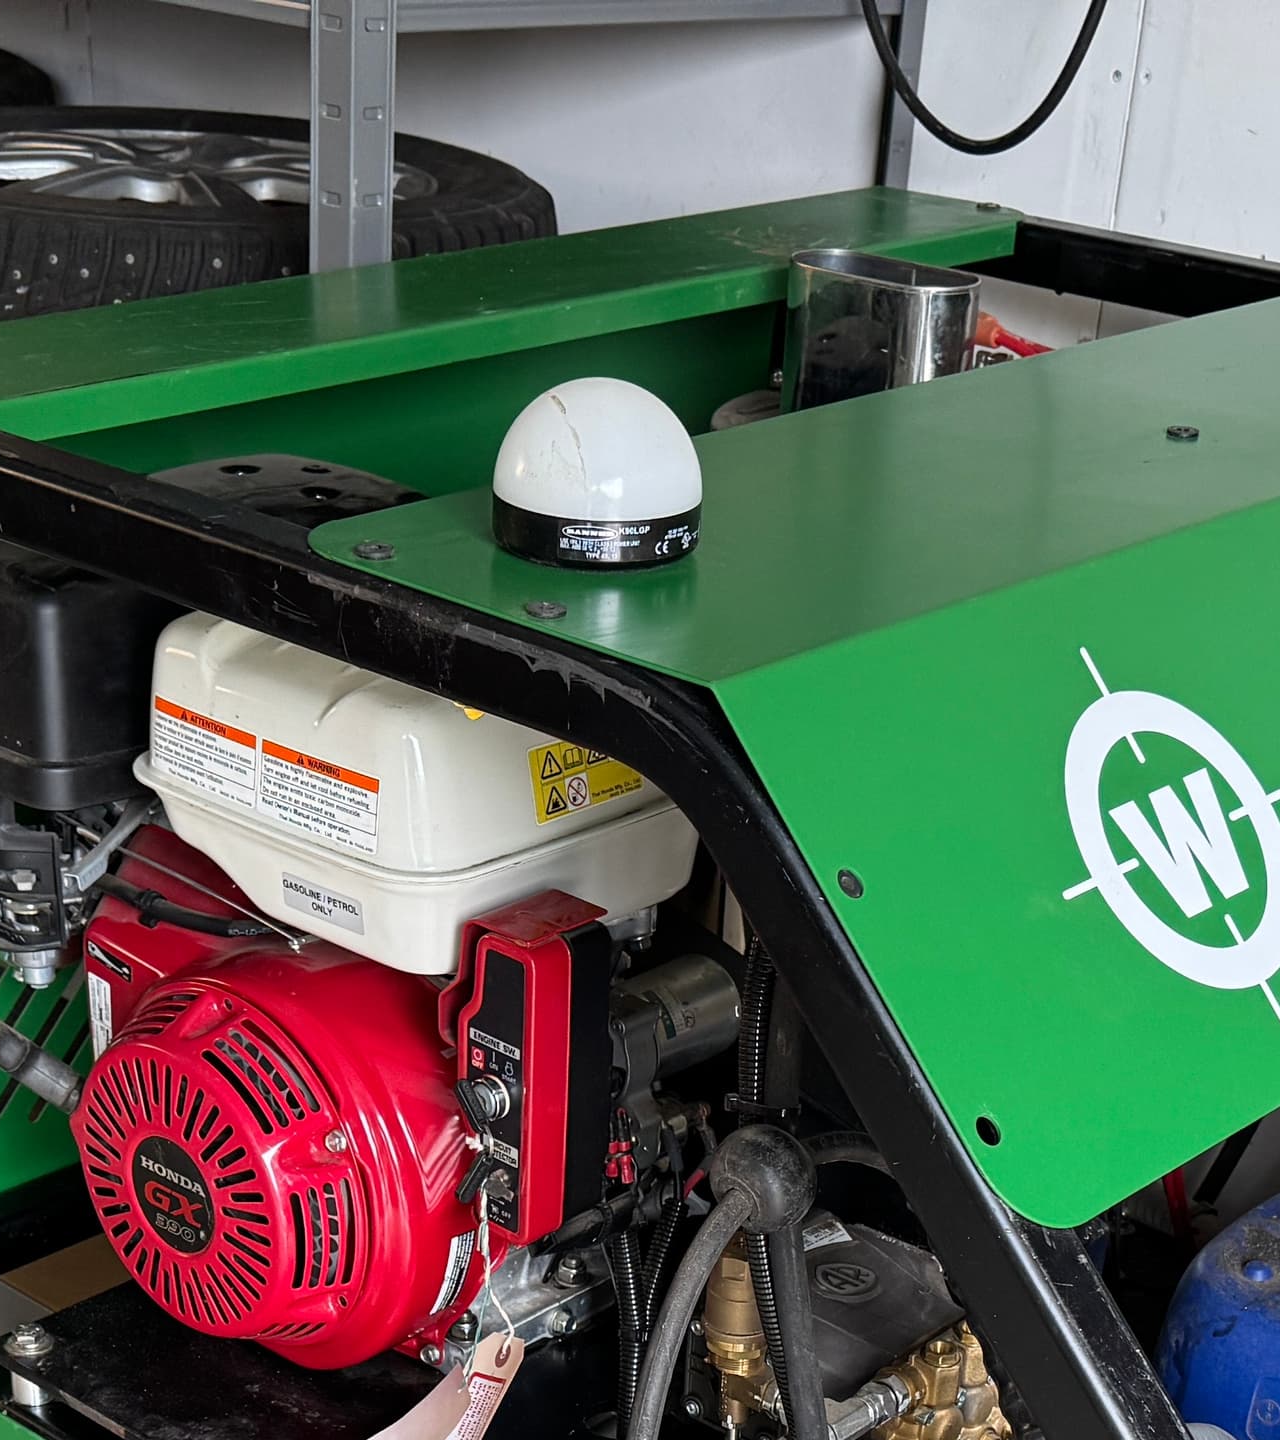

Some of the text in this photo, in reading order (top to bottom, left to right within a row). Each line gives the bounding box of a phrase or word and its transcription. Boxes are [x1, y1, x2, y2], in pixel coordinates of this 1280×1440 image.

[565, 528, 617, 538] BANNER
[190, 714, 226, 735] ATTENTION
[306, 758, 340, 777] WARNING
[263, 776, 271, 784] The
[273, 781, 288, 792] engine
[275, 770, 290, 781] engine
[300, 778, 308, 786] and
[329, 788, 345, 800] before
[333, 780, 342, 789] and
[261, 796, 273, 806] Read
[311, 814, 325, 826] before
[1108, 767, 1250, 919] W
[282, 879, 321, 902] GASOLINE
[327, 896, 359, 916] PETROL
[311, 902, 333, 917] ONLY
[473, 1030, 503, 1053] ENGINE
[140, 1155, 206, 1198] HONDA
[144, 1180, 203, 1229] GX
[155, 1212, 196, 1243] 390
